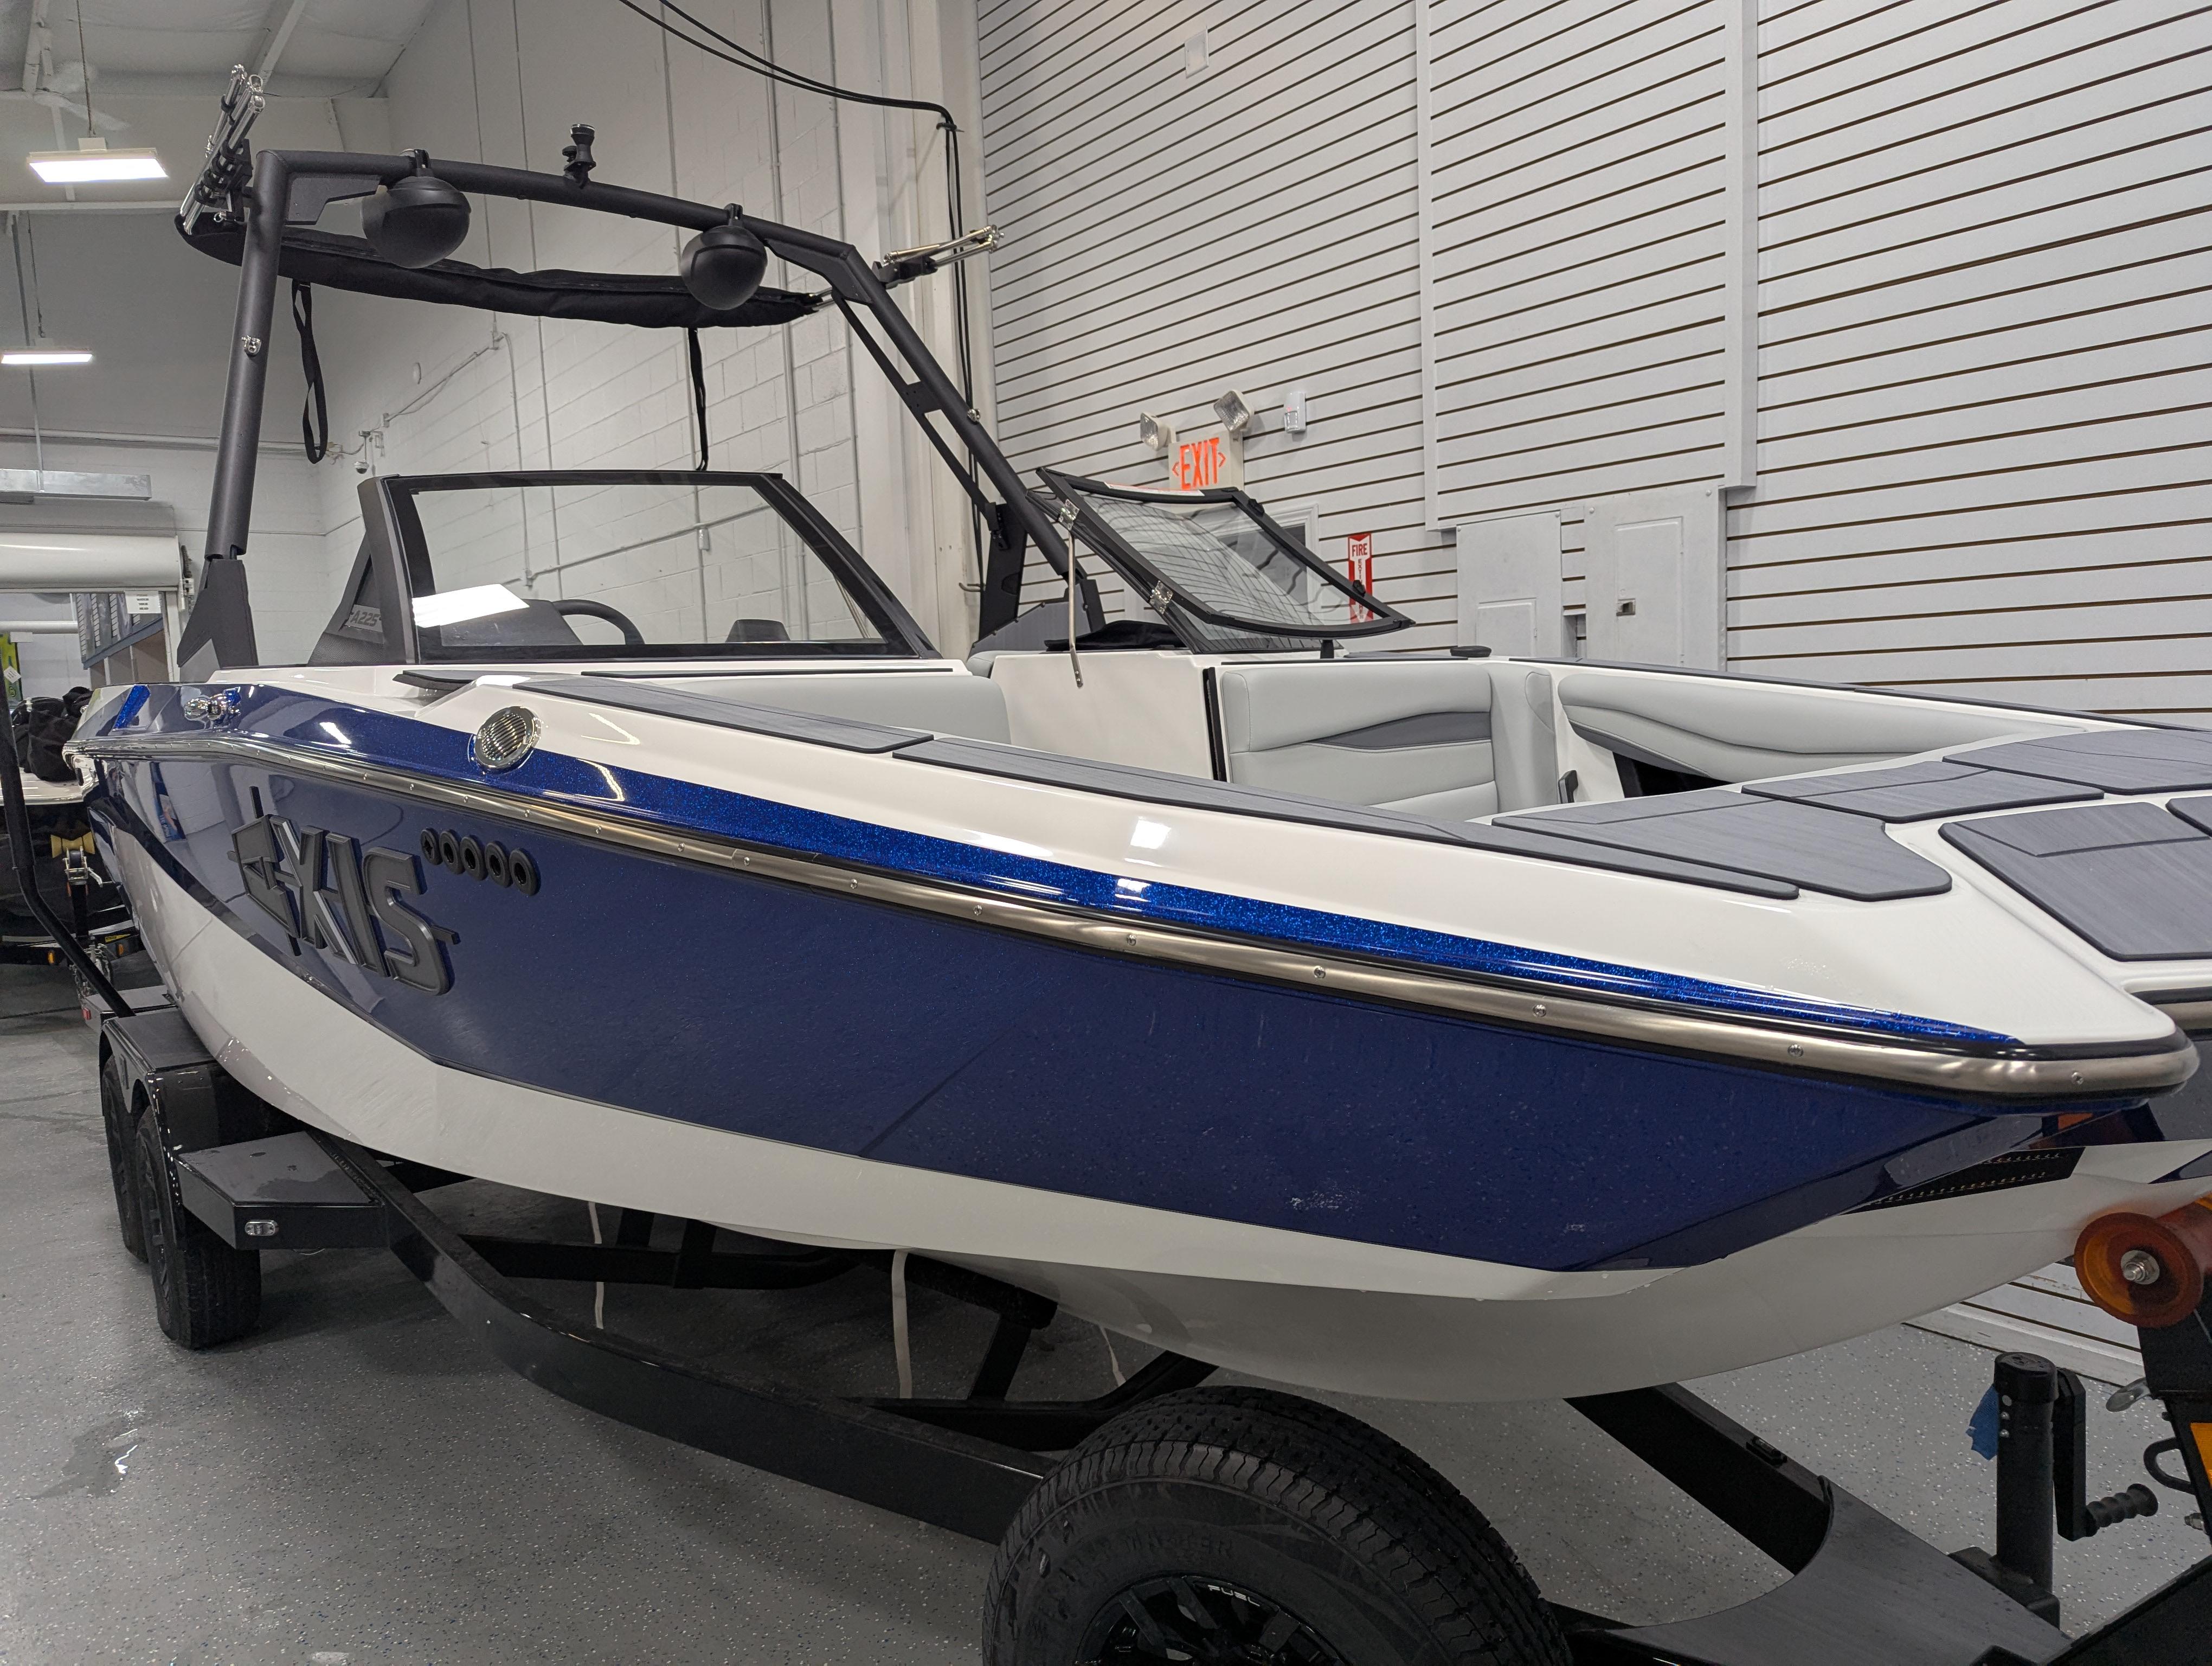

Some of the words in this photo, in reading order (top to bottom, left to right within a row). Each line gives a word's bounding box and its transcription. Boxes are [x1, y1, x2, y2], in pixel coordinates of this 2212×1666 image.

[1180, 437, 1219, 490] EXIT
[1352, 543, 1368, 557] FIRE
[230, 813, 455, 996] AXIS
[1207, 1584, 1261, 1607] FUEL
